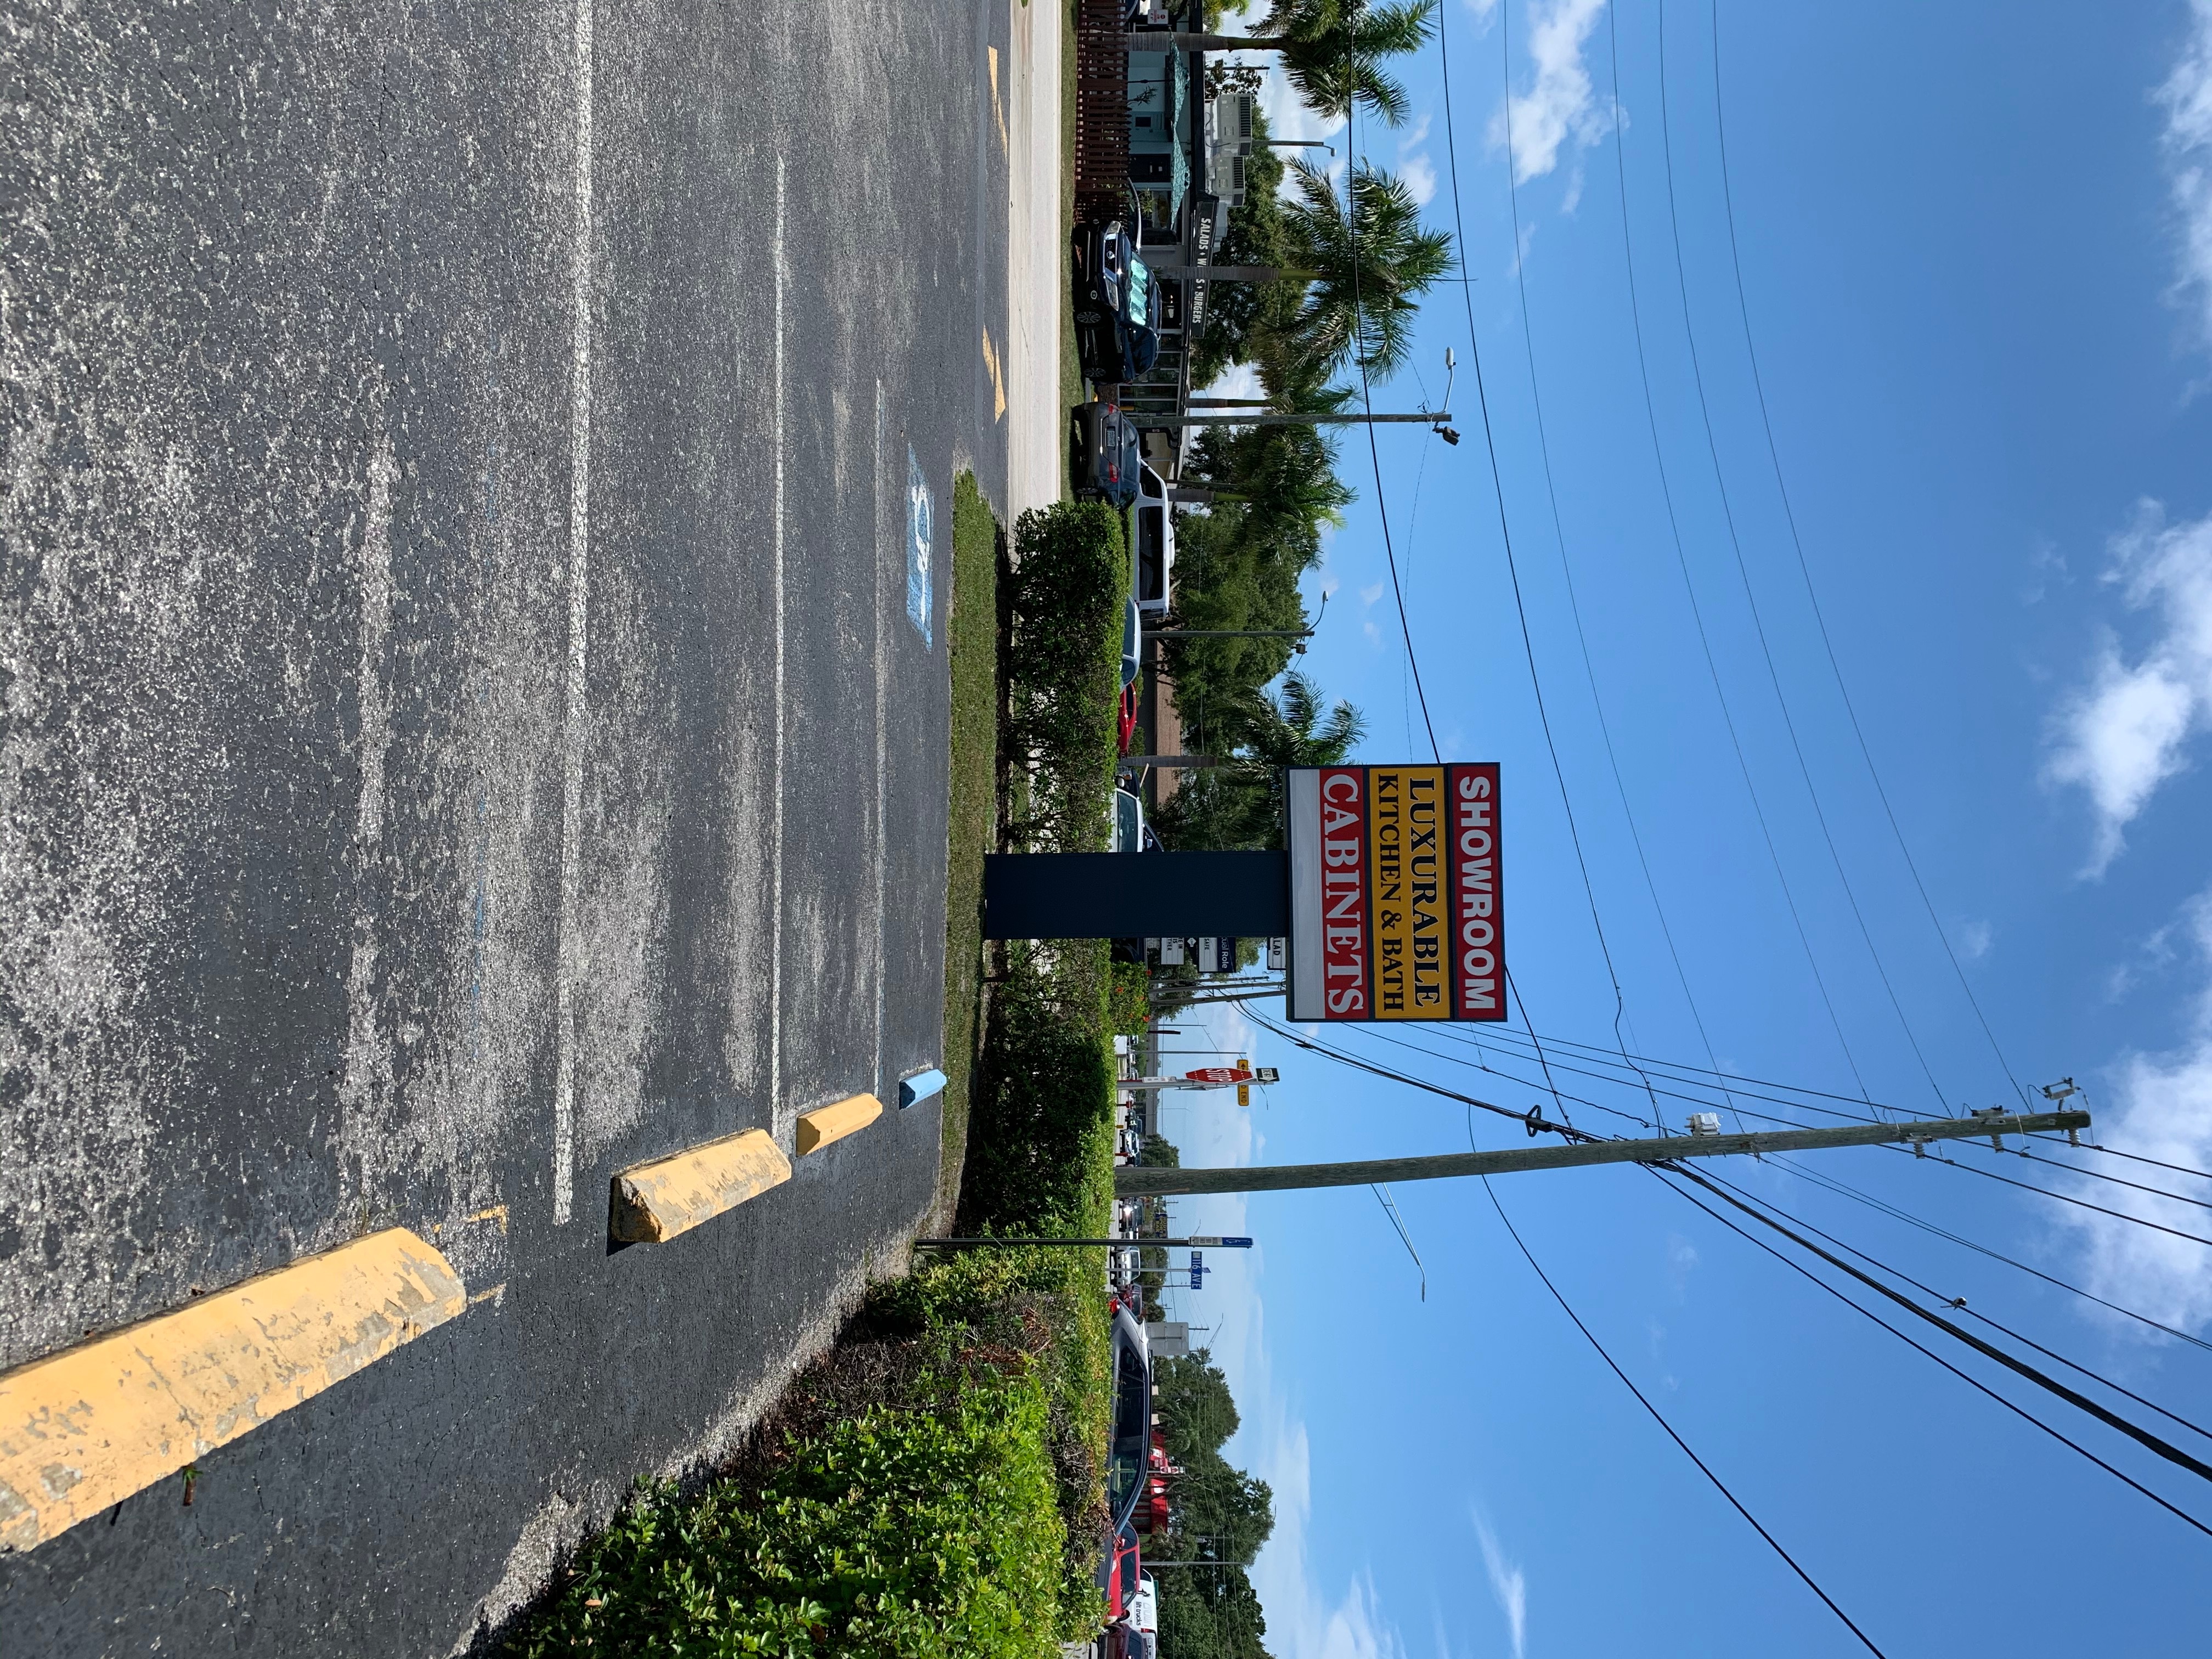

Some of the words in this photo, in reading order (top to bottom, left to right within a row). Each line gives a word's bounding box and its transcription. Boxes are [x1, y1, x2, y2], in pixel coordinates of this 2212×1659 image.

[1198, 218, 1211, 250] SALADS
[1192, 291, 1204, 324] BURGERS
[1378, 774, 1401, 902] KITCHEN
[1323, 774, 1364, 1013] CABINETS
[1409, 778, 1441, 1007] LUXURABLE
[1459, 776, 1496, 1009] SHOWROOM
[1381, 910, 1402, 930] &
[1383, 938, 1404, 1011] BATH
[1205, 1069, 1232, 1082] STOP
[1192, 1259, 1201, 1269] 116
[1192, 1273, 1200, 1288] AVE
